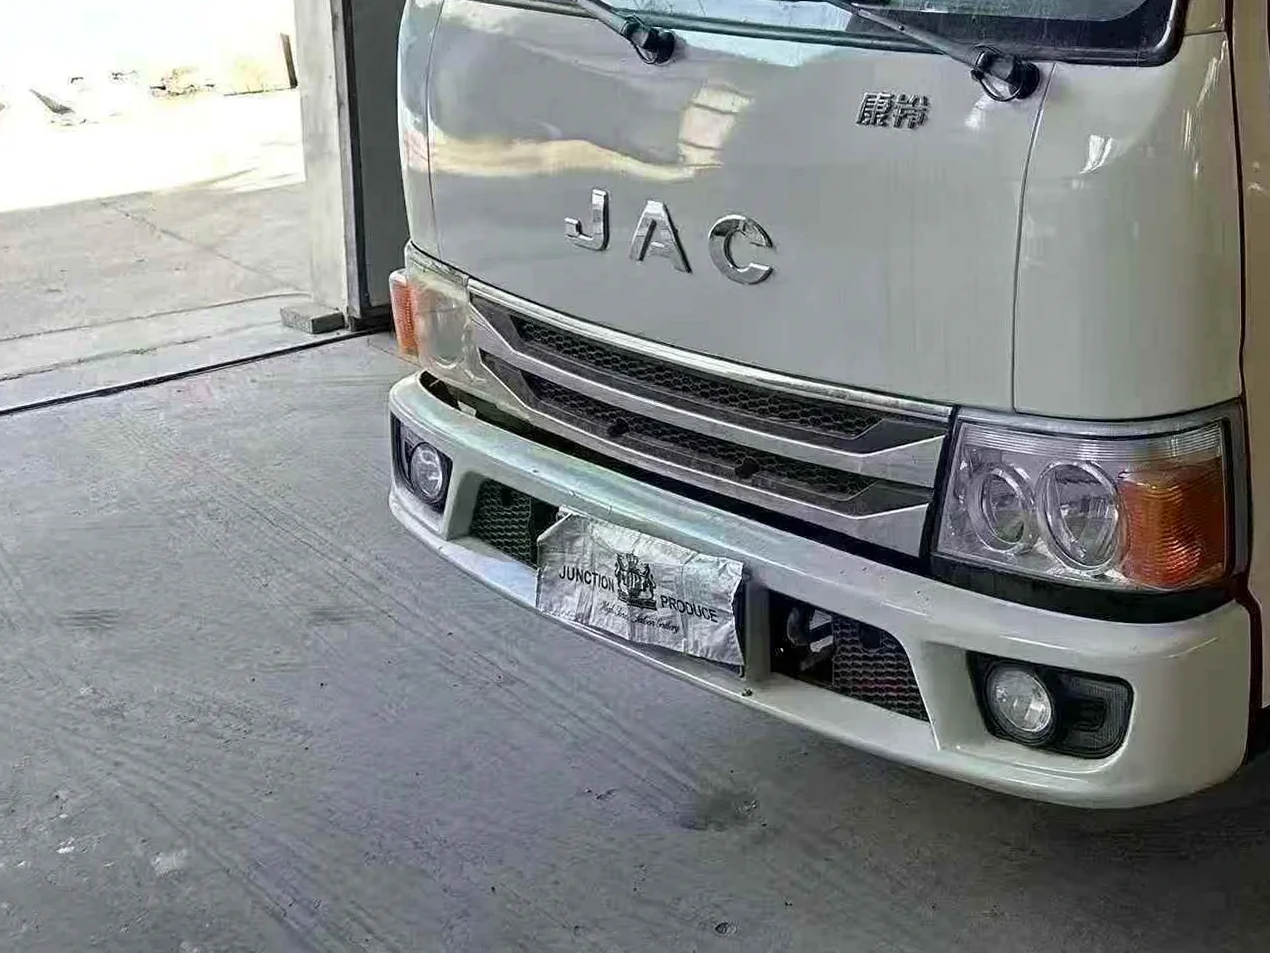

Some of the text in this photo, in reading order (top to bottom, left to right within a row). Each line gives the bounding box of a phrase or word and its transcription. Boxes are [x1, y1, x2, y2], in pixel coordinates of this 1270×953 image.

[564, 188, 777, 286] JAC
[559, 565, 615, 592] JUNCTION
[660, 595, 719, 623] PRODUCE
